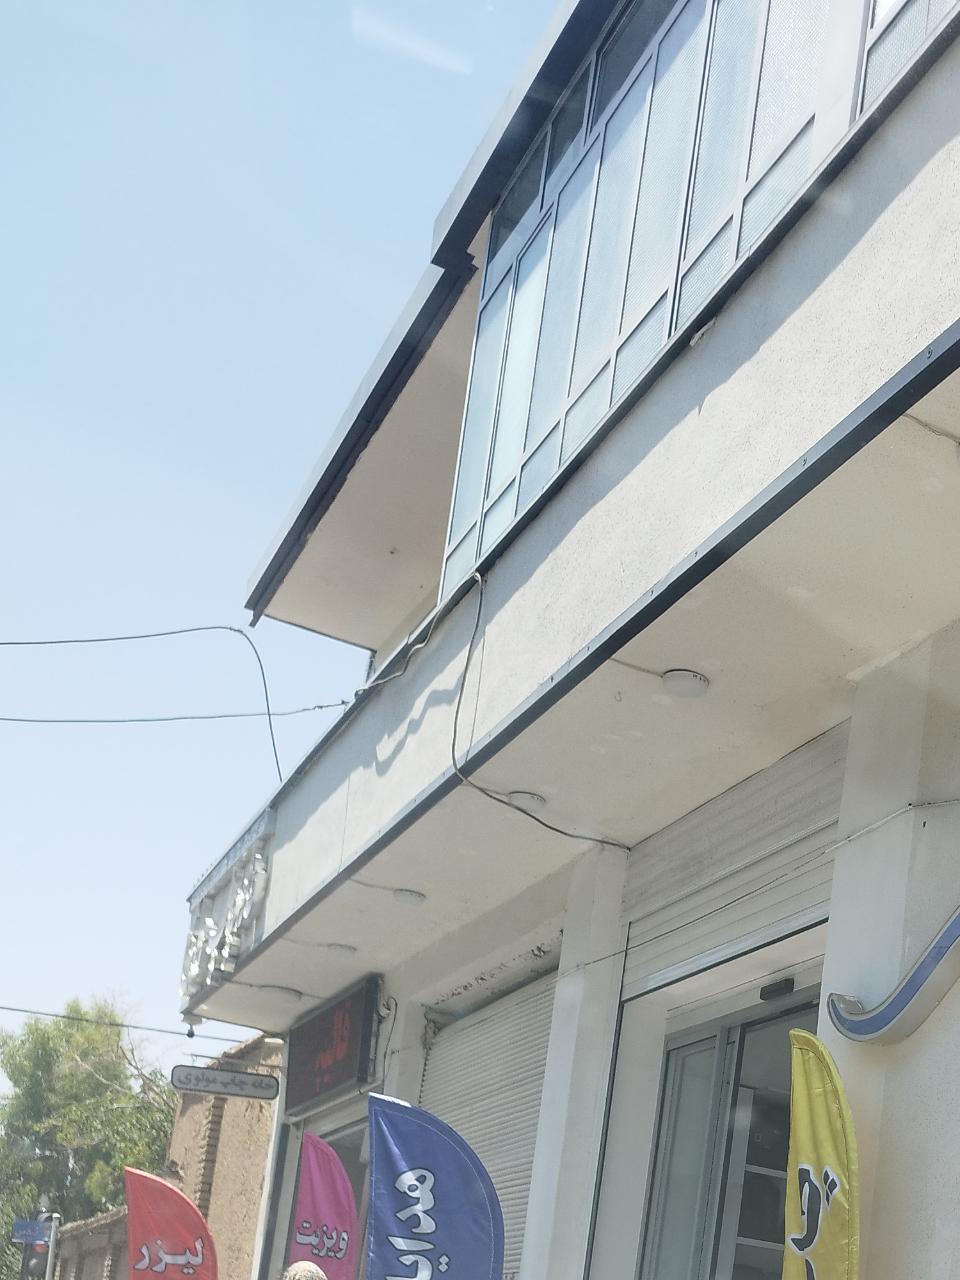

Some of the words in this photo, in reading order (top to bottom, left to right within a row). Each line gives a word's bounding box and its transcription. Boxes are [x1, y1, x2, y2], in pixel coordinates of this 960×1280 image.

[177, 1070, 217, 1088] مولوی
[133, 1237, 205, 1274] لیزر
[295, 1220, 349, 1261] ویزیت
